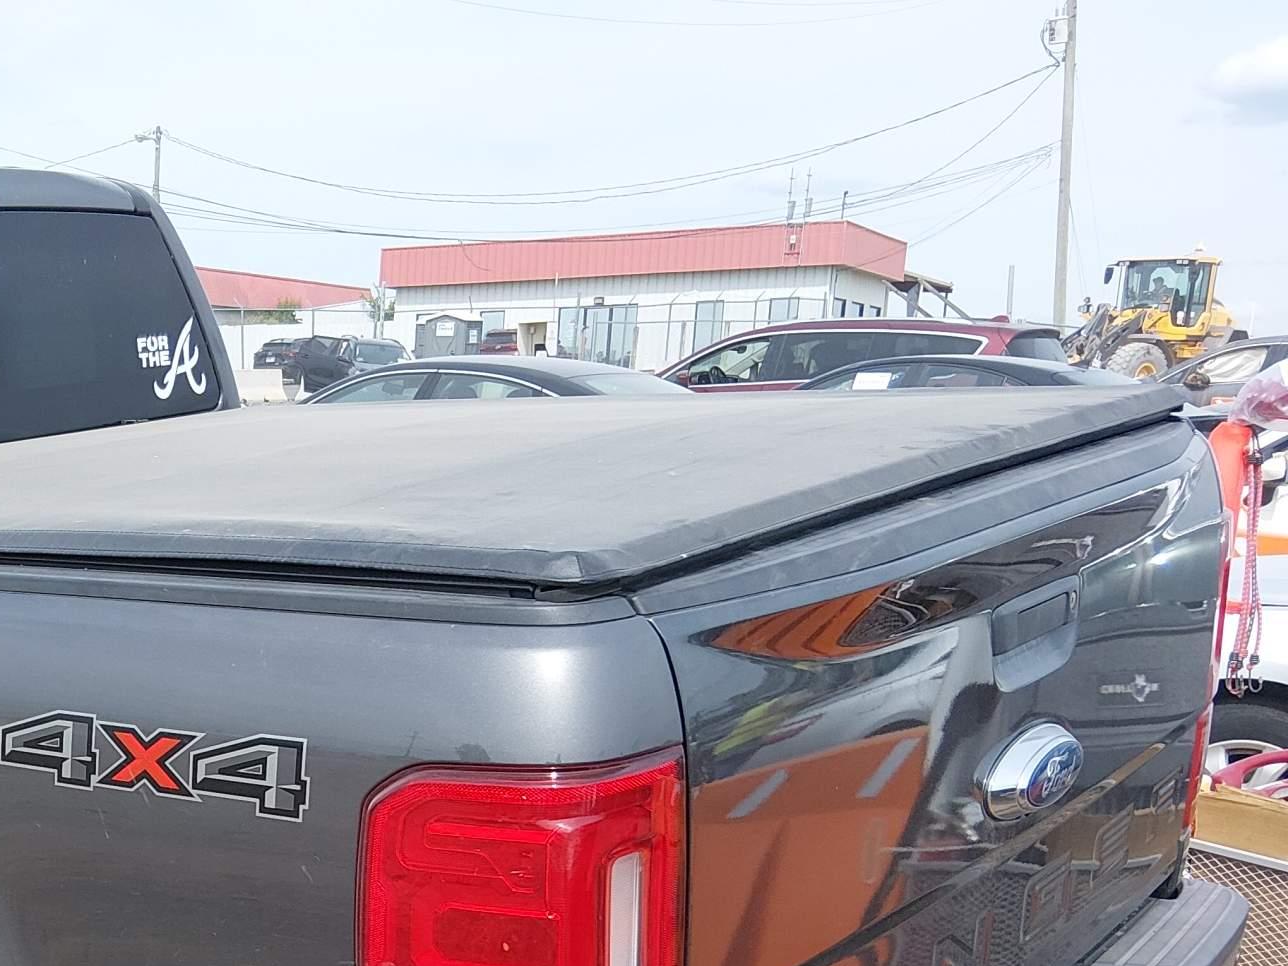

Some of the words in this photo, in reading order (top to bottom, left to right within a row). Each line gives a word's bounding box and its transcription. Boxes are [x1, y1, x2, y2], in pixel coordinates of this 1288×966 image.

[136, 335, 169, 352] FOR
[138, 350, 171, 368] THE
[153, 315, 207, 400] A
[1040, 750, 1078, 799] Ford
